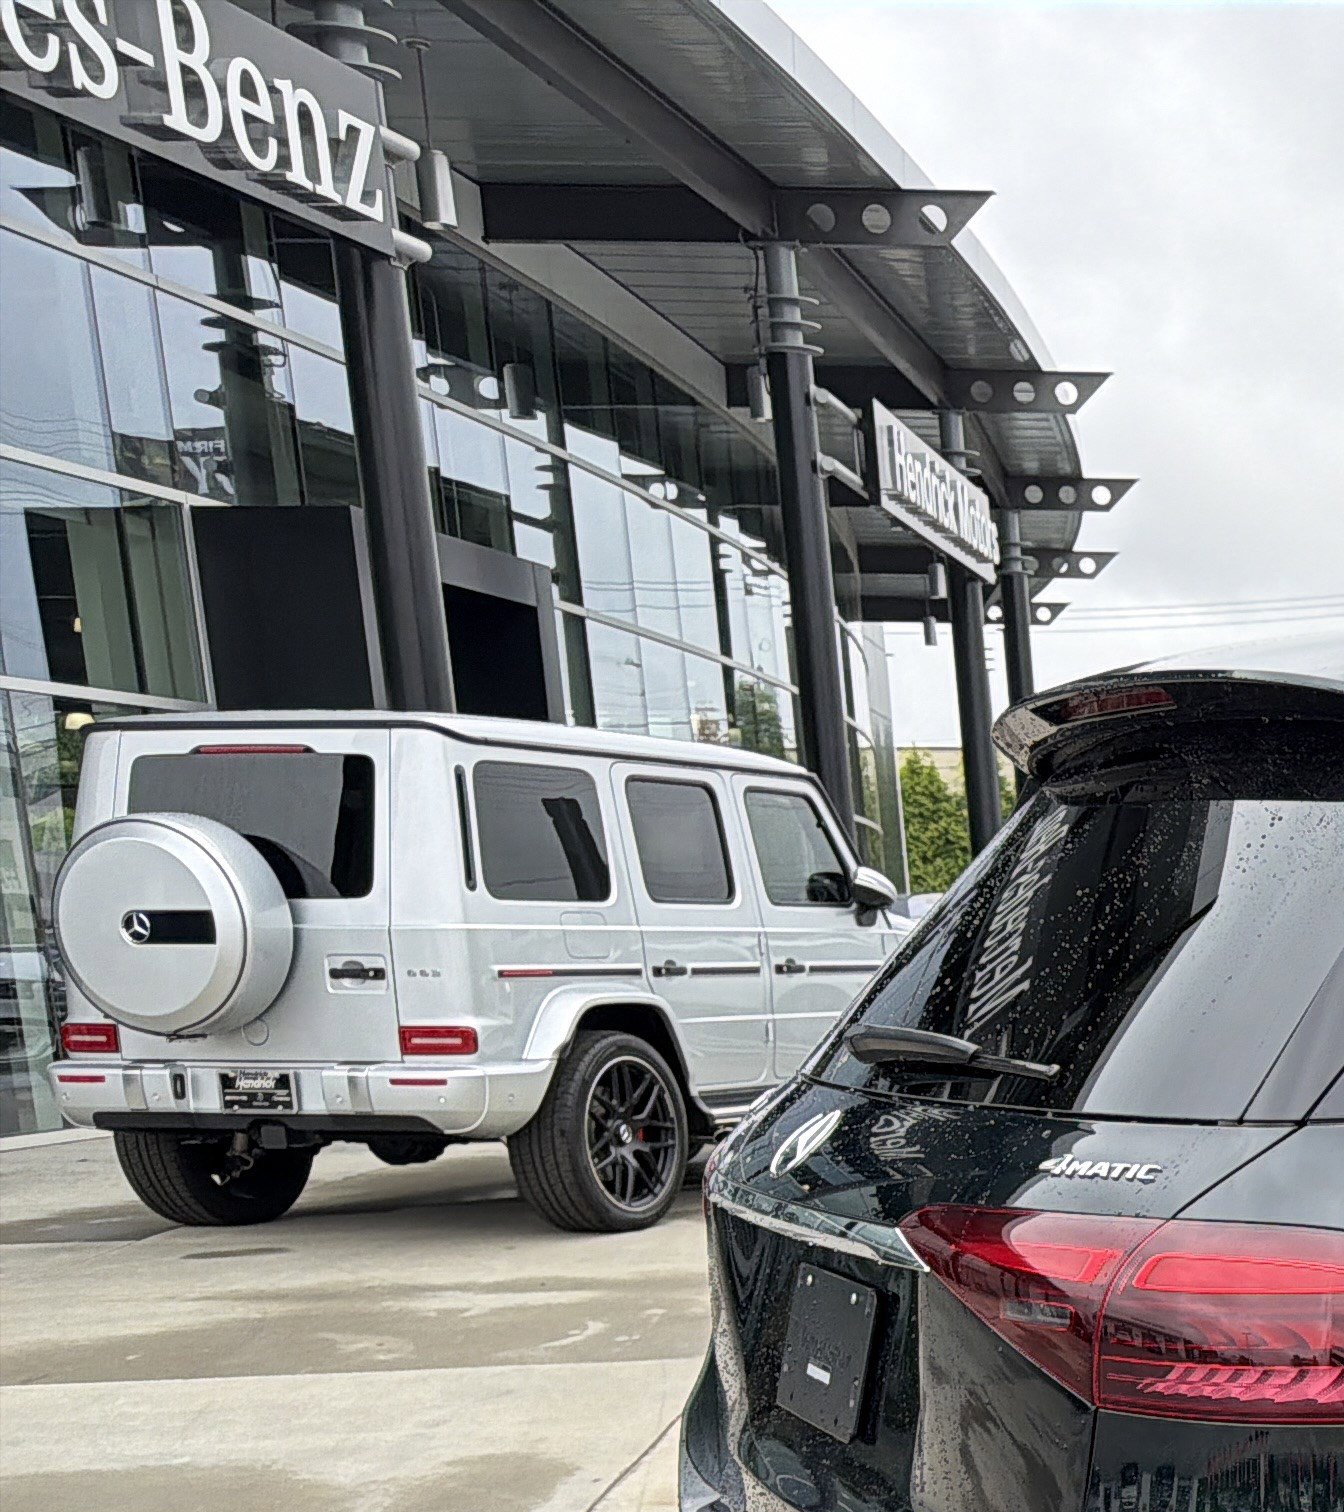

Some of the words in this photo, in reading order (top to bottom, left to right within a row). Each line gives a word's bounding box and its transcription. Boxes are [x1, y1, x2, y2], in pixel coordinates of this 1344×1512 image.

[892, 424, 959, 536] Hendrick
[956, 478, 1000, 566] Motors
[1039, 1153, 1163, 1182] 4MATIC
